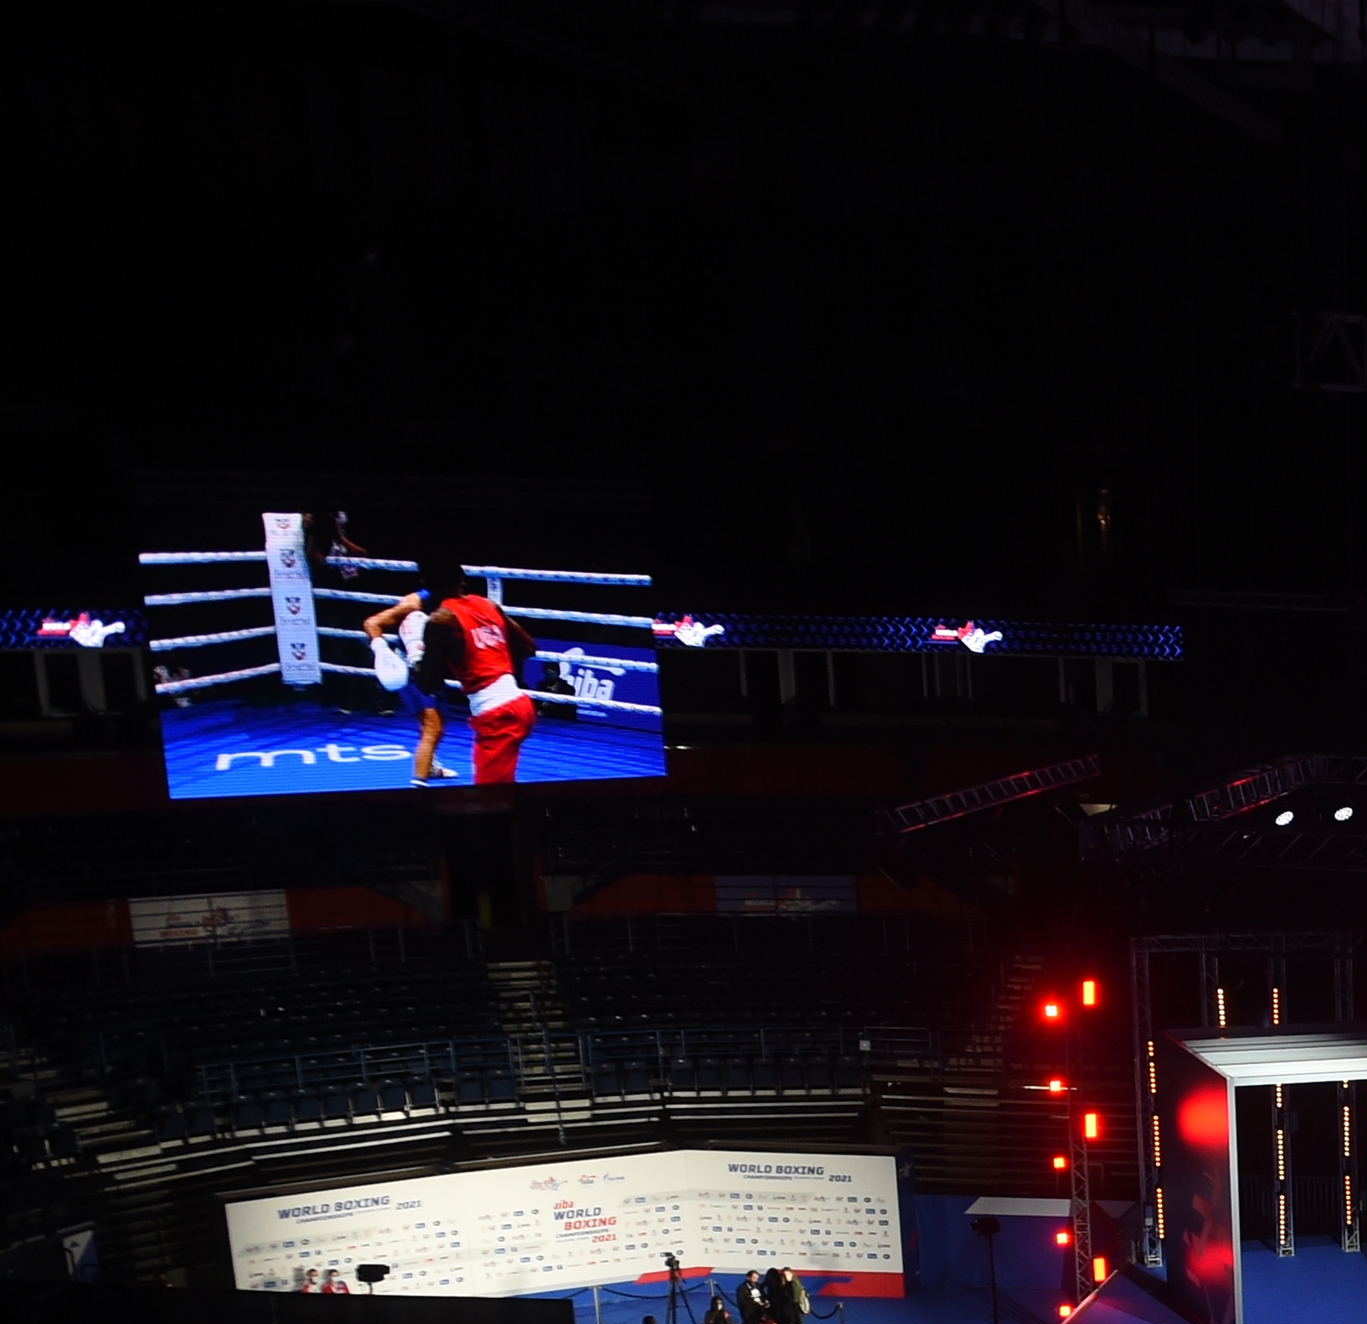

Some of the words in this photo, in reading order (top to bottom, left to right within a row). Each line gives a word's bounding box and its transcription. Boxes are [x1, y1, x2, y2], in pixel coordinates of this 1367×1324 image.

[215, 743, 413, 771] mts
[728, 1164, 772, 1174] WORLD
[775, 1165, 825, 1176] BOXING
[828, 1174, 853, 1183] 2021
[278, 1203, 330, 1219] WORLD
[334, 1195, 391, 1212] BOXING
[395, 1200, 423, 1211] 2021
[552, 1200, 574, 1210] aiba
[553, 1207, 602, 1221] WORLD
[564, 1216, 617, 1231] BOXING
[591, 1234, 618, 1244] 2021
